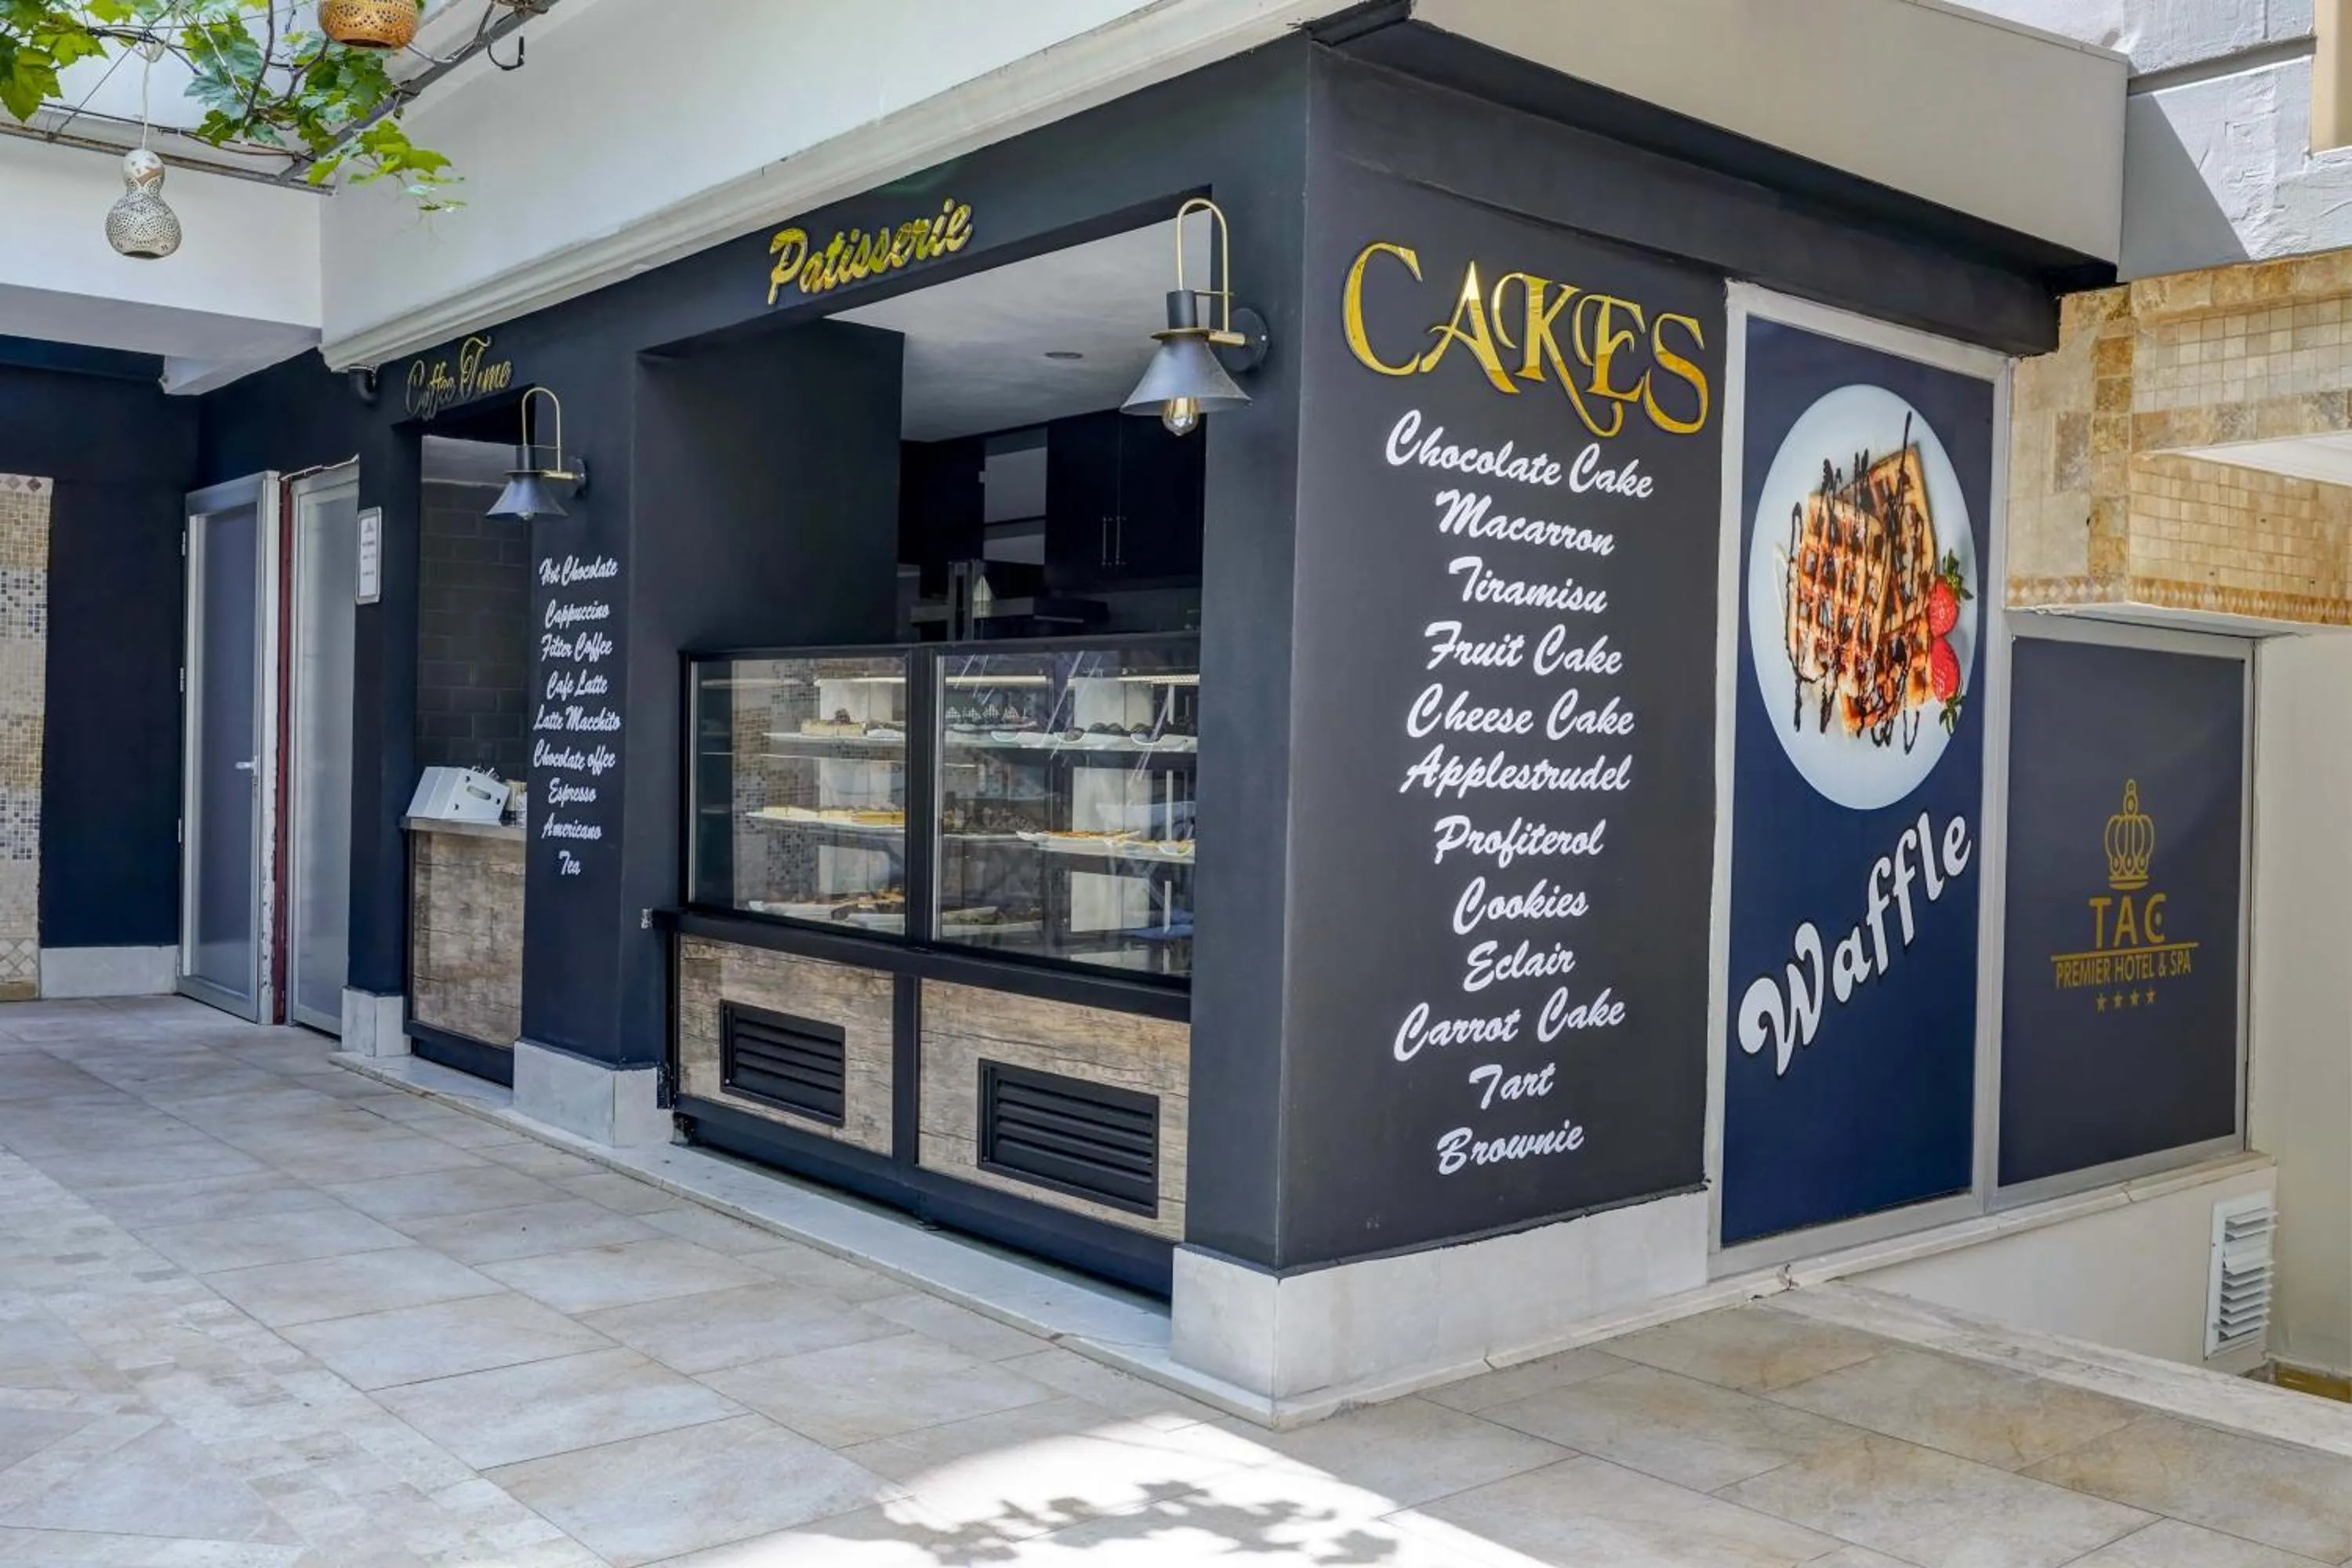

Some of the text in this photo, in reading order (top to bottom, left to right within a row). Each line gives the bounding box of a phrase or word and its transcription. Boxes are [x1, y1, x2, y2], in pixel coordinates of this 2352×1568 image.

[768, 198, 973, 305] Patisserie
[1342, 241, 1709, 438] CAKES
[1385, 409, 1653, 498] Chocolate Cake
[1435, 488, 1615, 556] Macarron
[561, 554, 618, 587] Chocolate
[1448, 556, 1608, 613] Tiramisu
[545, 598, 610, 630] Cappuccino
[574, 631, 613, 662] Coffee
[1424, 621, 1622, 676] Fruit Cake
[546, 669, 608, 701] Cafe Latte
[1406, 683, 1635, 740] Cheese Cake
[532, 703, 564, 731] Latte
[533, 738, 616, 776] Chocolate offee
[1399, 743, 1633, 798] Applestrudel
[548, 777, 597, 808] Espresso
[541, 812, 602, 840] Americano
[1434, 815, 1606, 869] Profiterol
[559, 850, 581, 876] Tea
[1453, 876, 1589, 935] Cookies
[2089, 892, 2166, 949] TAC
[1463, 939, 1576, 992] Eclair
[1738, 811, 1972, 1077] Waffle
[2056, 947, 2192, 989] PREMIER HOTEL & SPA
[1393, 986, 1626, 1062] Carrot Cake
[1468, 1062, 1556, 1110] Tart
[1436, 1120, 1585, 1175] Brownie
